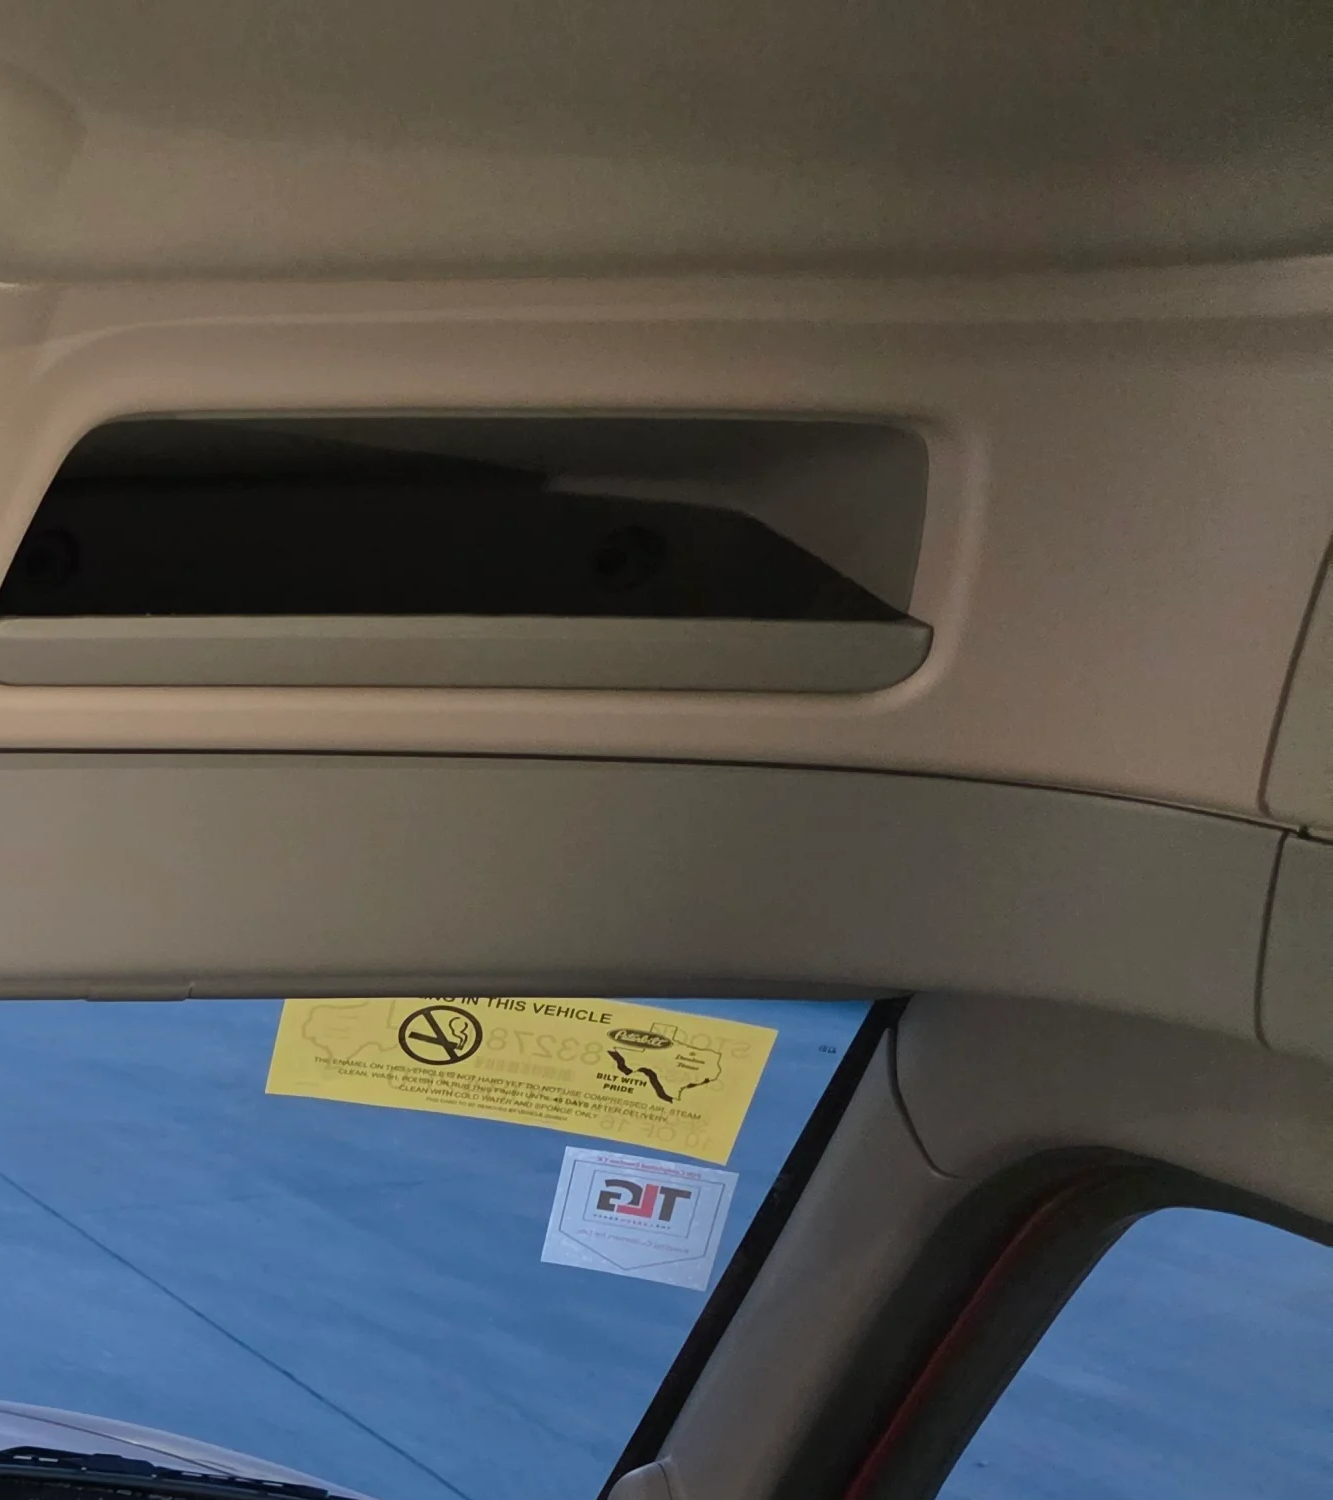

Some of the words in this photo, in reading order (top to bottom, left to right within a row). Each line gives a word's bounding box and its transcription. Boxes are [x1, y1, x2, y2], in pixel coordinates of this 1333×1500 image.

[487, 997, 526, 1012] THIS
[533, 1002, 613, 1025] VEHICLE
[614, 1029, 669, 1048] Peterbilt
[369, 1062, 384, 1070] ON
[456, 1073, 476, 1081] NOT
[505, 1080, 525, 1089] YET
[525, 1082, 541, 1090] DO
[541, 1085, 563, 1094] NOT
[562, 1088, 582, 1097] USE
[583, 1092, 648, 1110] COMPRESSED
[668, 1109, 702, 1120] STEAM
[596, 1072, 619, 1082] BILT
[621, 1075, 648, 1087] WITH
[603, 1082, 635, 1095] PRIDE
[398, 1083, 429, 1094] CLEAN
[430, 1088, 453, 1098] WITH
[454, 1091, 479, 1101] COLD
[481, 1094, 512, 1105] WATER
[513, 1099, 533, 1108] AND
[534, 1102, 573, 1115] SPONGE
[494, 1087, 524, 1097] FINISH
[564, 1098, 590, 1109] DAYS
[590, 1103, 622, 1114] AFTER
